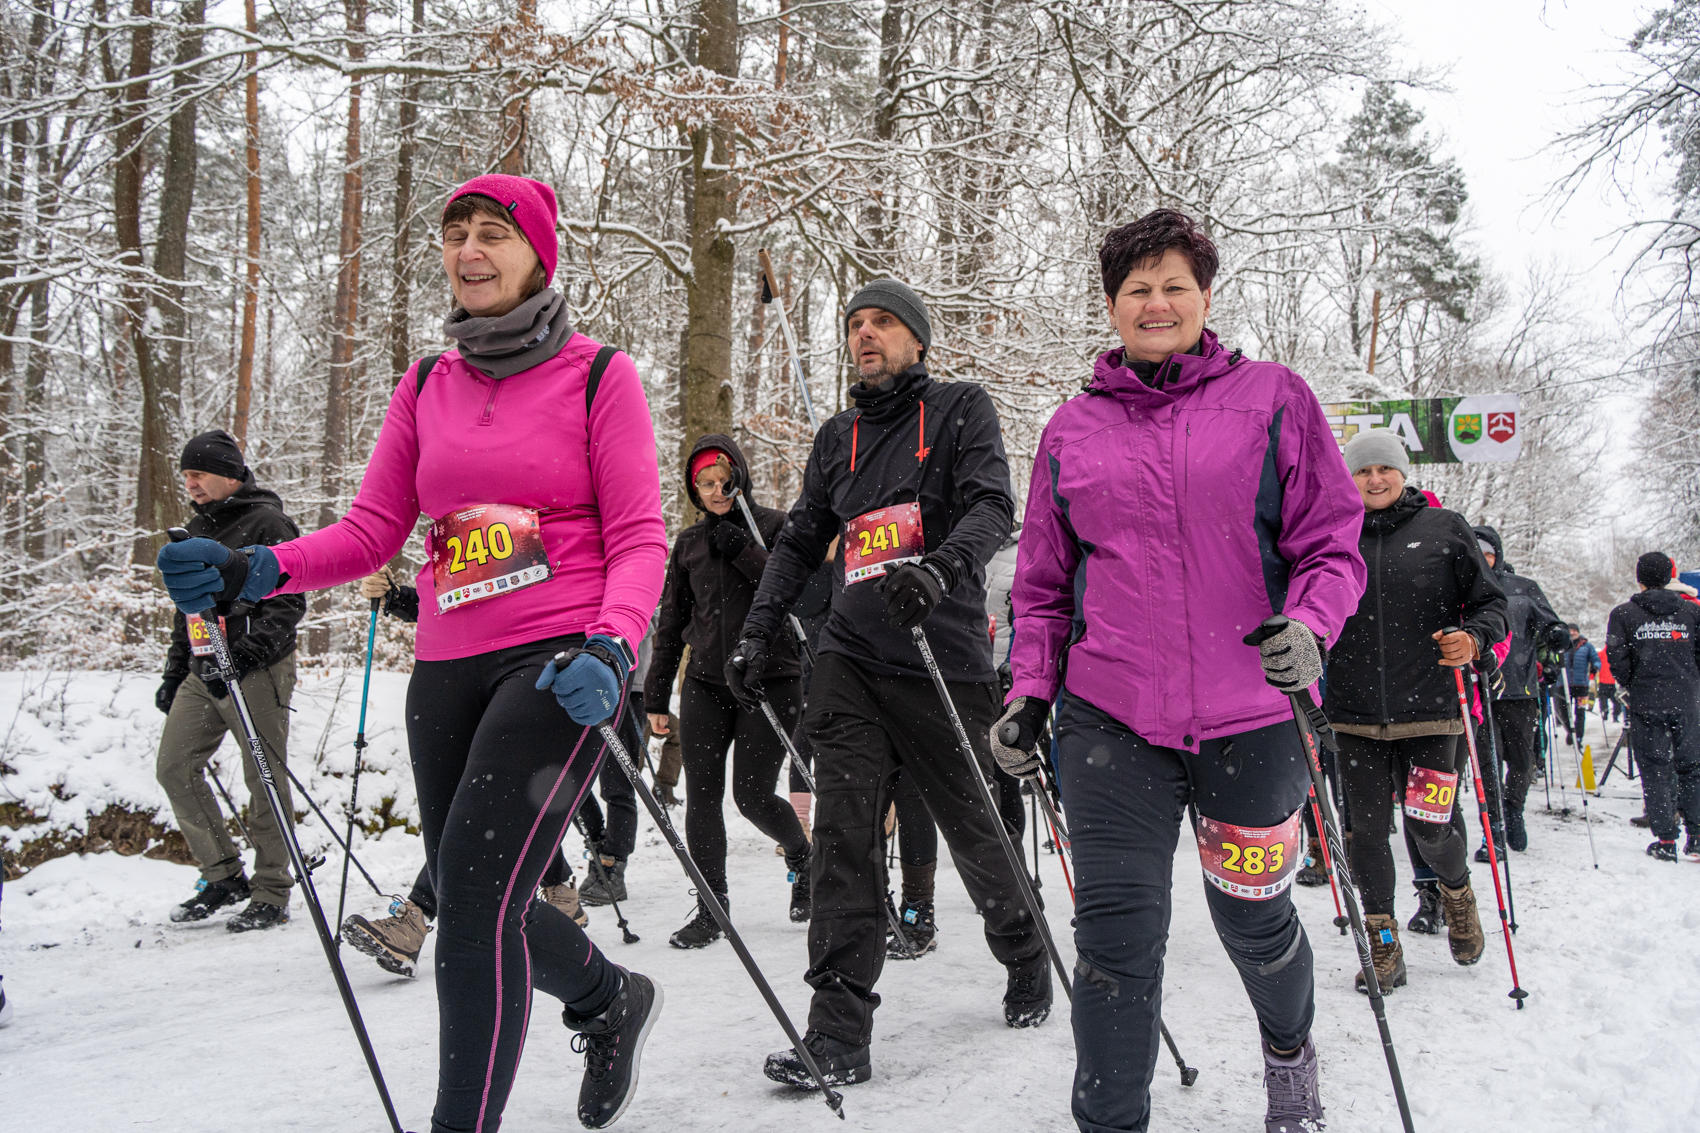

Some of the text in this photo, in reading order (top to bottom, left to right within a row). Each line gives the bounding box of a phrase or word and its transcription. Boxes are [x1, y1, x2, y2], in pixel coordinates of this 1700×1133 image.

[446, 522, 514, 575] 240
[858, 522, 900, 557] 241
[248, 737, 273, 779] newfeel
[1221, 842, 1285, 875] 283
